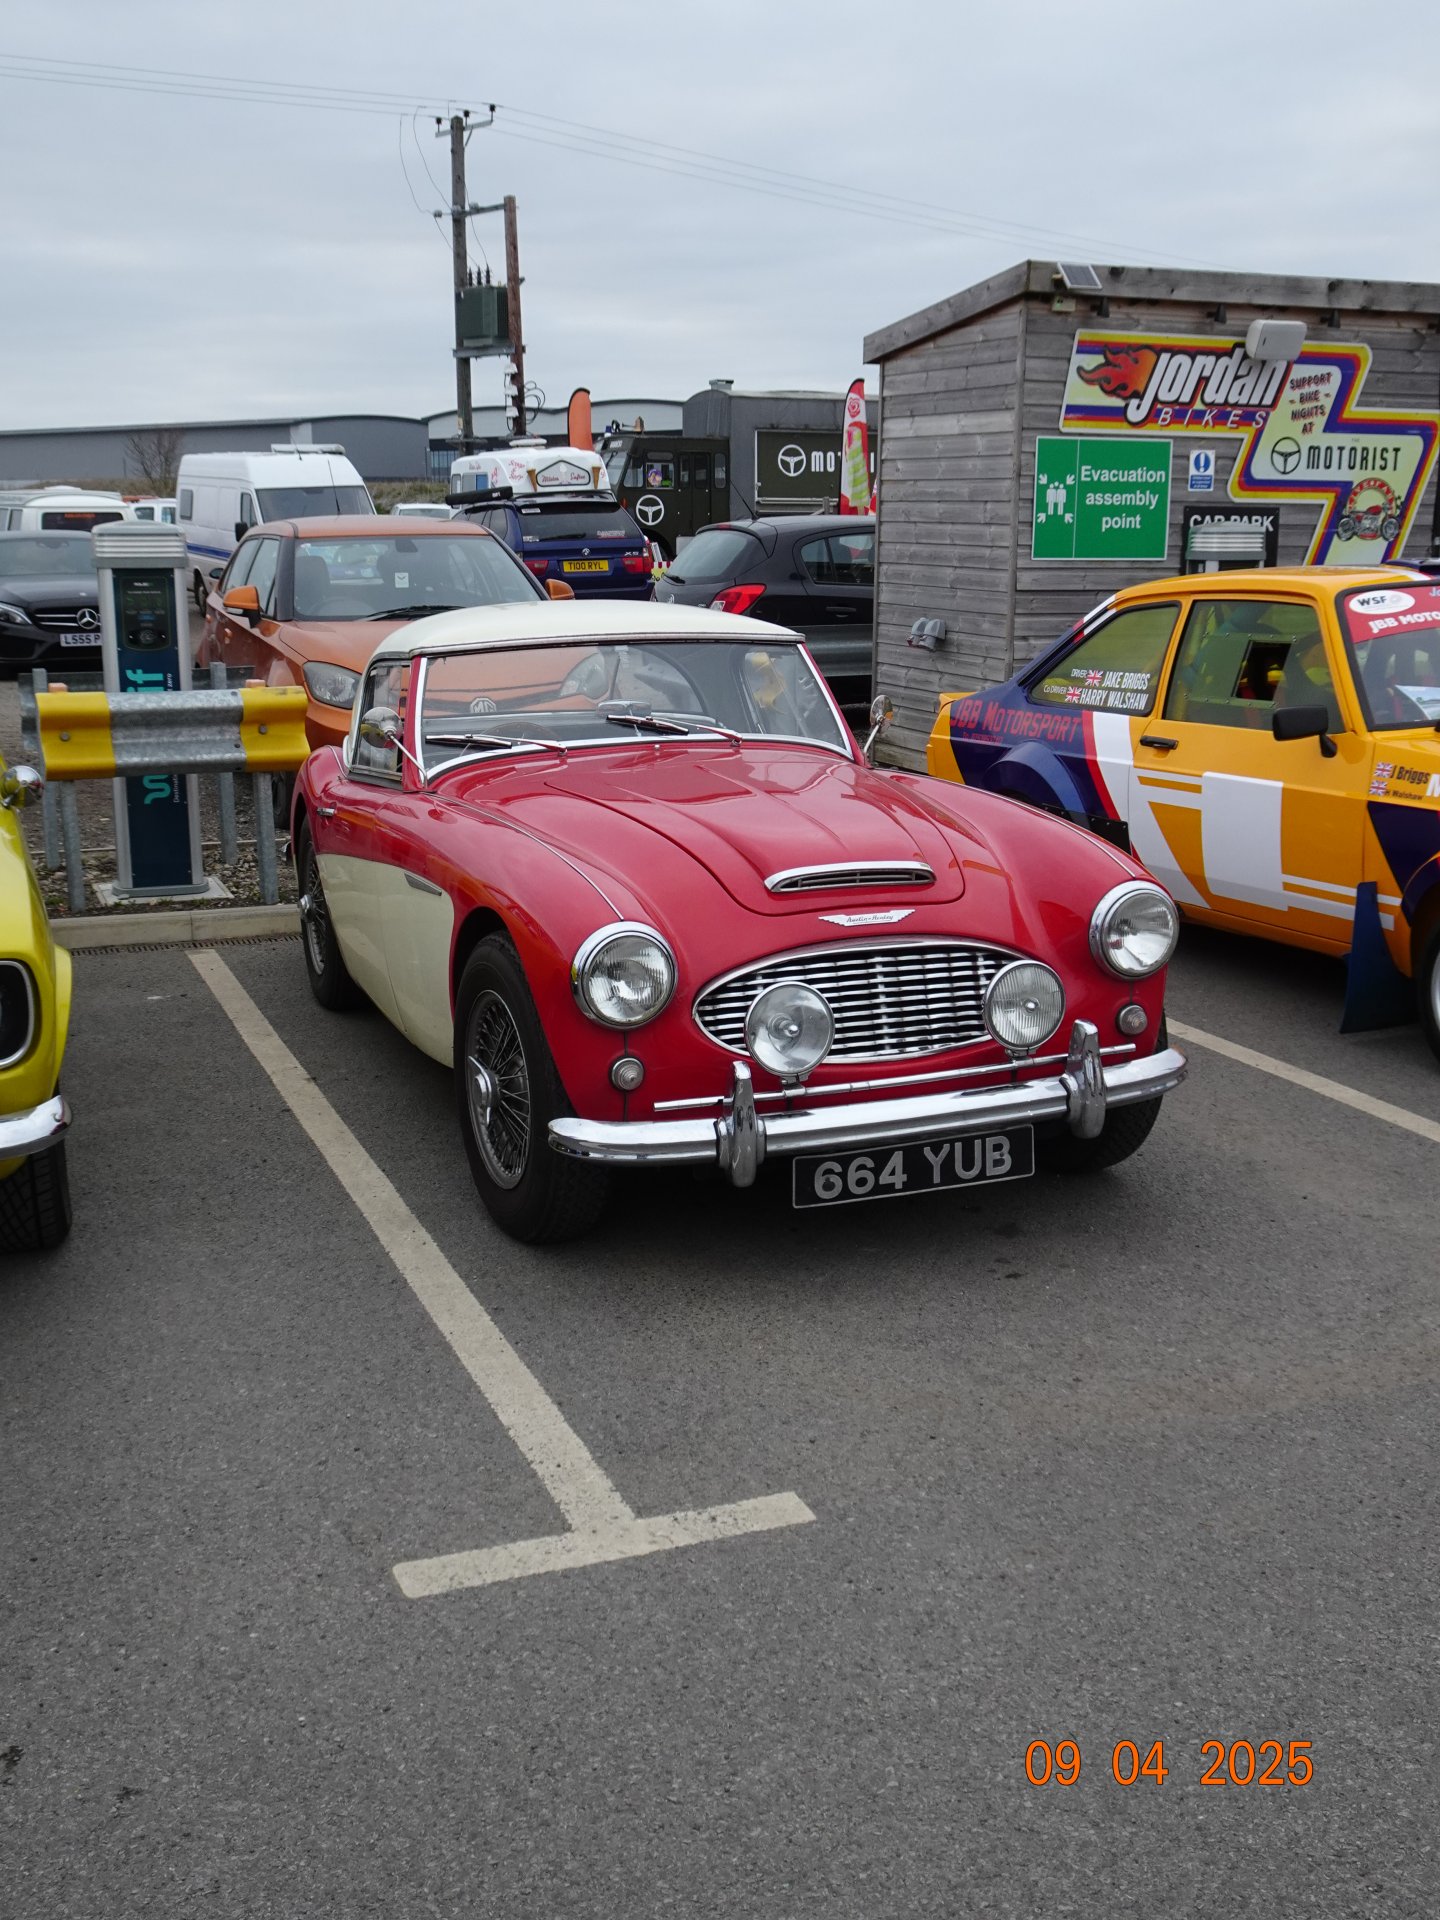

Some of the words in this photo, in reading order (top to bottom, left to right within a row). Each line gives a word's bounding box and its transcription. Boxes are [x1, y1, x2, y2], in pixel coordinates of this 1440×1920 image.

[1289, 372, 1333, 390] SUPPORT
[1299, 390, 1321, 405] BIKE
[1158, 407, 1267, 430] BIKES
[1290, 404, 1326, 422] NIGHTS
[1301, 422, 1314, 435] AT
[811, 450, 875, 474] MOI
[1306, 445, 1401, 472] MOTORIST
[1080, 465, 1166, 483] Evacuation
[1085, 490, 1159, 510] assembly
[1101, 513, 1141, 532] point
[588, 562, 603, 571] RYL
[1357, 595, 1387, 607] WSF
[1368, 617, 1399, 634] JBB
[1101, 671, 1124, 689] JAKE
[1121, 672, 1151, 691] BRIGGS
[1079, 688, 1108, 706] HARRY
[1107, 690, 1149, 711] WALSHAW
[949, 699, 983, 729] JBB
[1396, 766, 1430, 785] Briggs
[813, 1151, 908, 1200] 664
[923, 1135, 1012, 1185] YUB
